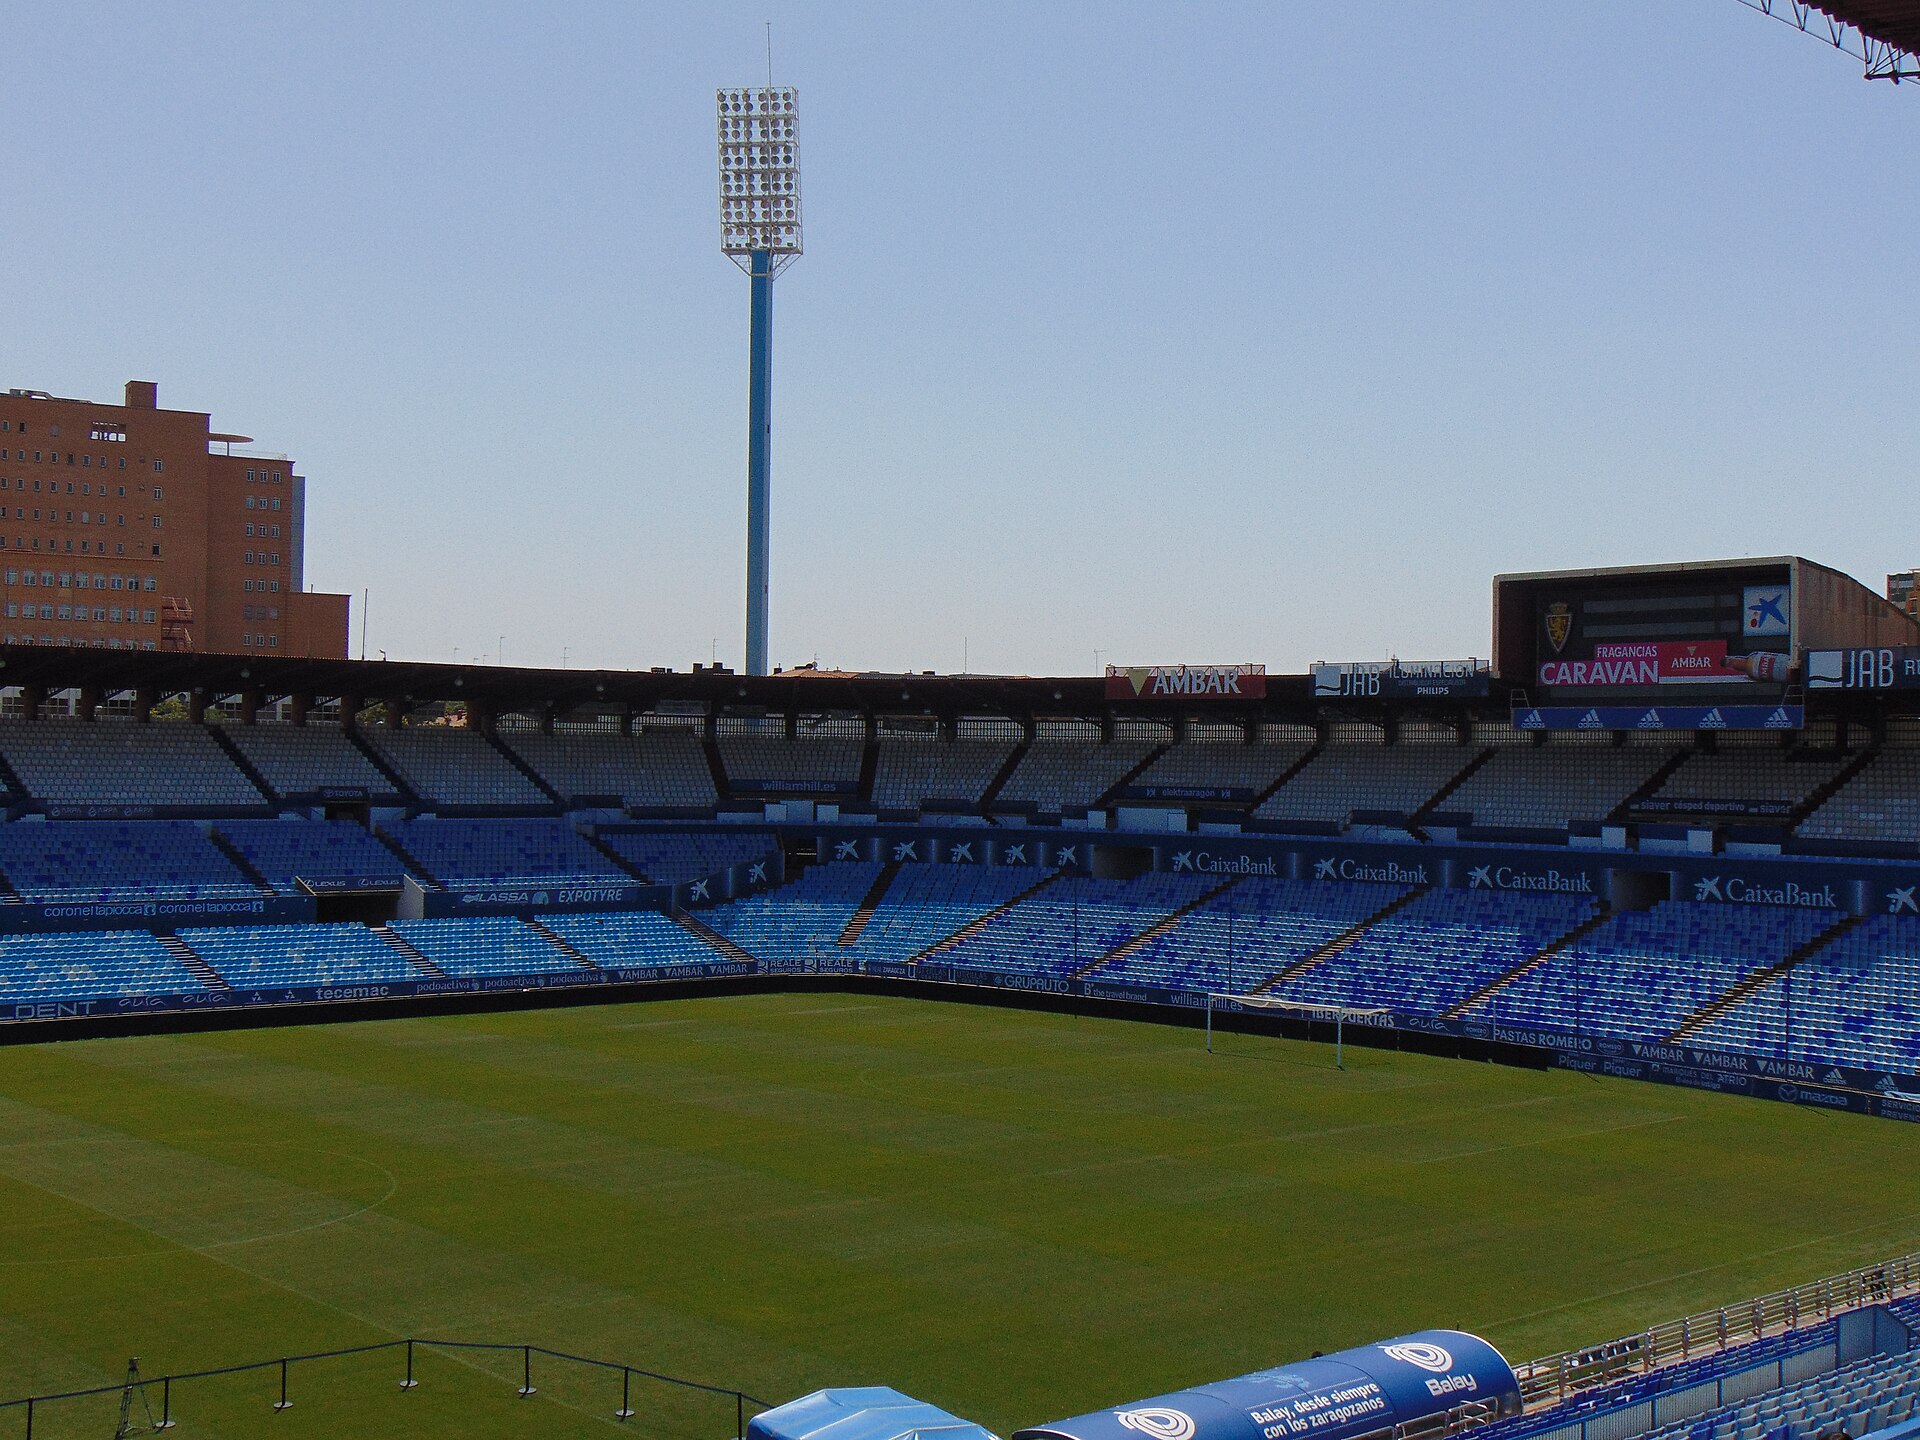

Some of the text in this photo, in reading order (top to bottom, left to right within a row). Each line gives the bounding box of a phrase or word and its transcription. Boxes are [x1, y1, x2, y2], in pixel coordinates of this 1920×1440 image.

[1596, 646, 1657, 658] FRAGANCIAS
[1671, 657, 1712, 669] AMBAR
[1846, 649, 1894, 688] JAB
[1539, 660, 1659, 685] CARAVAN
[1151, 669, 1242, 695] AMBAR
[1417, 687, 1449, 695] PHILIPS
[762, 780, 837, 791] williamhill.es
[1196, 852, 1277, 875] CaixaBank
[1340, 859, 1428, 884] CaixaBank
[315, 879, 346, 887] LEXUS
[369, 878, 400, 886] LEXUS
[1496, 866, 1593, 893] CaixaBank
[558, 889, 623, 903] EXPOTYRE
[1726, 878, 1837, 908] CaixaBank
[715, 963, 748, 974] AMBAR
[770, 959, 802, 967] REALE
[819, 959, 853, 967] REALE
[625, 968, 658, 979] AMBAR
[671, 966, 704, 977] AMBAR
[417, 980, 470, 992] podoactiva
[485, 977, 536, 989] podoactiva
[550, 974, 599, 985] podoactiva
[1004, 974, 1069, 993] GRUPAUTO
[182, 993, 227, 1004] aura
[316, 985, 389, 1000] tecemac
[1126, 992, 1147, 1001] brand
[118, 996, 166, 1008] aura
[0, 1001, 97, 1020] DENT
[1409, 1018, 1450, 1032] aura
[1494, 1028, 1536, 1043] PASTAS
[1641, 1045, 1686, 1063] AMBAR
[1558, 1055, 1597, 1072] Piquer
[1603, 1061, 1642, 1078] Piquer
[1702, 1053, 1748, 1071] AMBAR
[1766, 1063, 1815, 1080] AMBAR
[1800, 1090, 1848, 1106] mazda
[1424, 1373, 1477, 1397] Balay
[1250, 1382, 1380, 1425] Balay, desde siempre
[1263, 1396, 1385, 1439] con los zaragozanos
